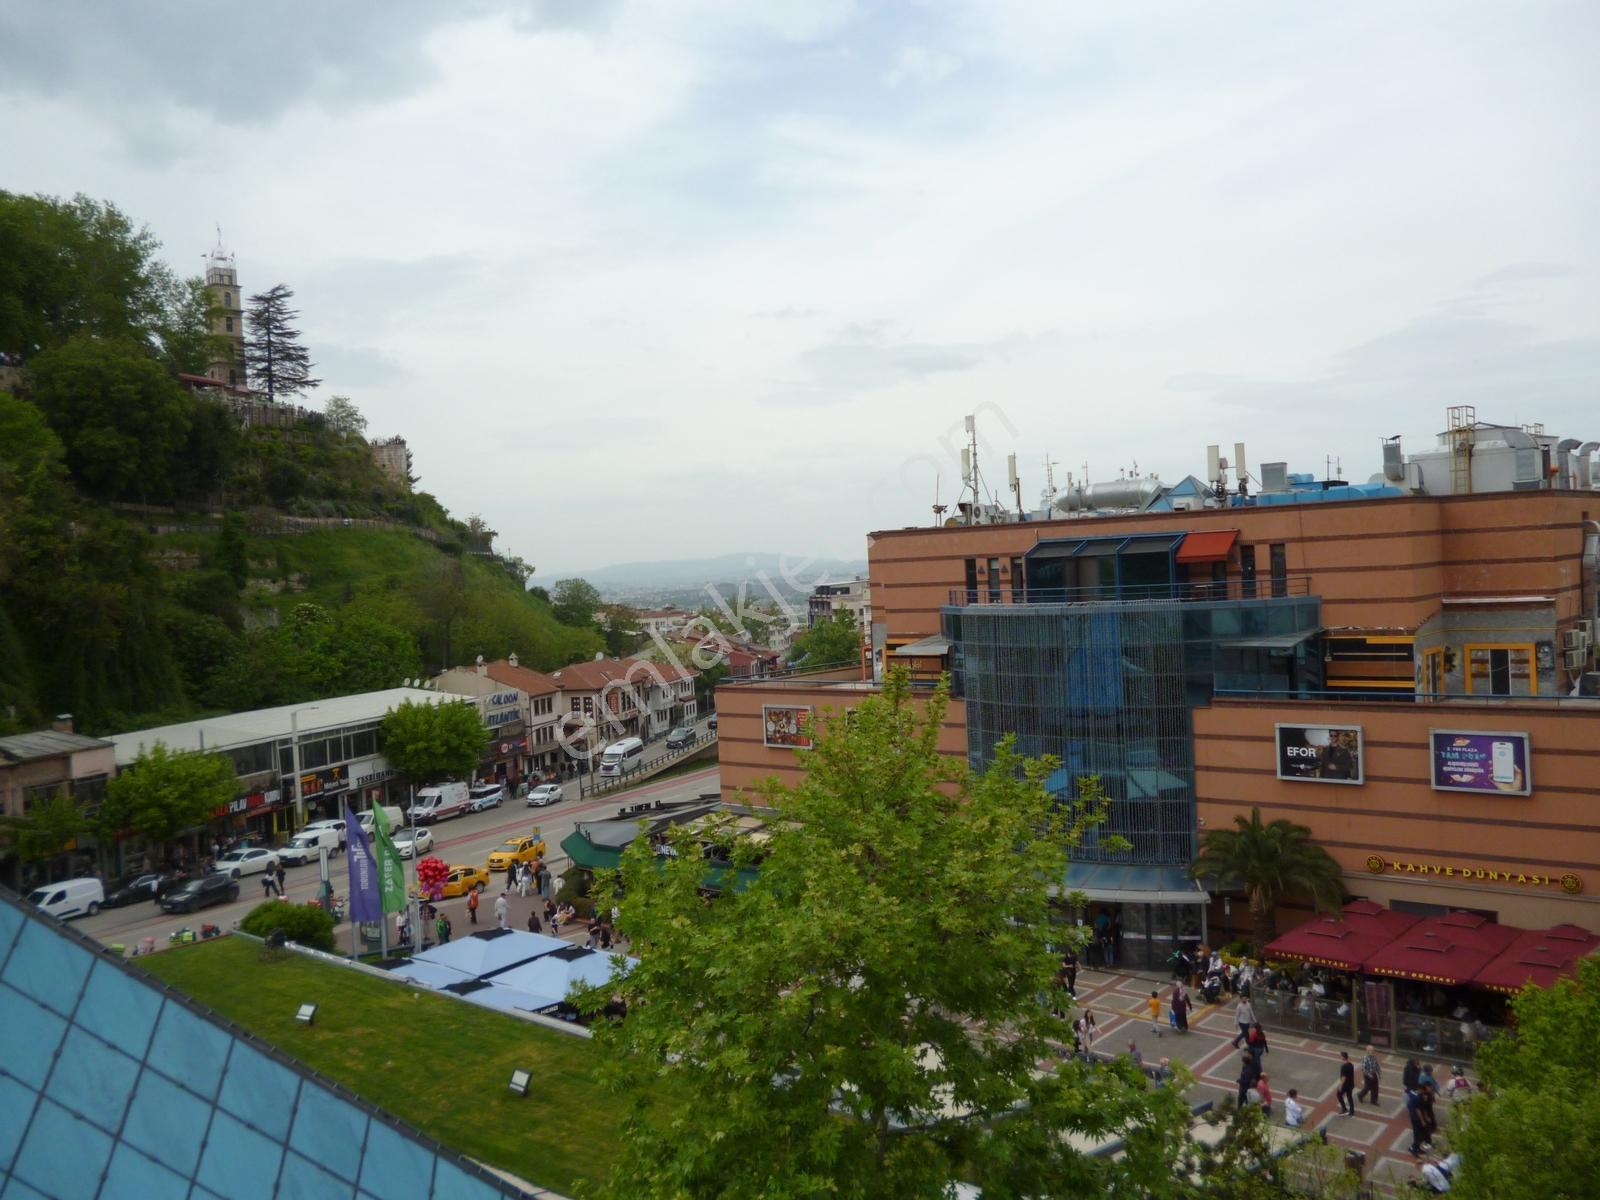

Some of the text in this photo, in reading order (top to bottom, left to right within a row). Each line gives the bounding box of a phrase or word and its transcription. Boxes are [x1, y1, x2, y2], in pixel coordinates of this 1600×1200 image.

[1286, 746, 1316, 757] EFOR
[1393, 861, 1549, 885] KAHVE DÜNYASI
[1374, 967, 1406, 976] KAHVE
